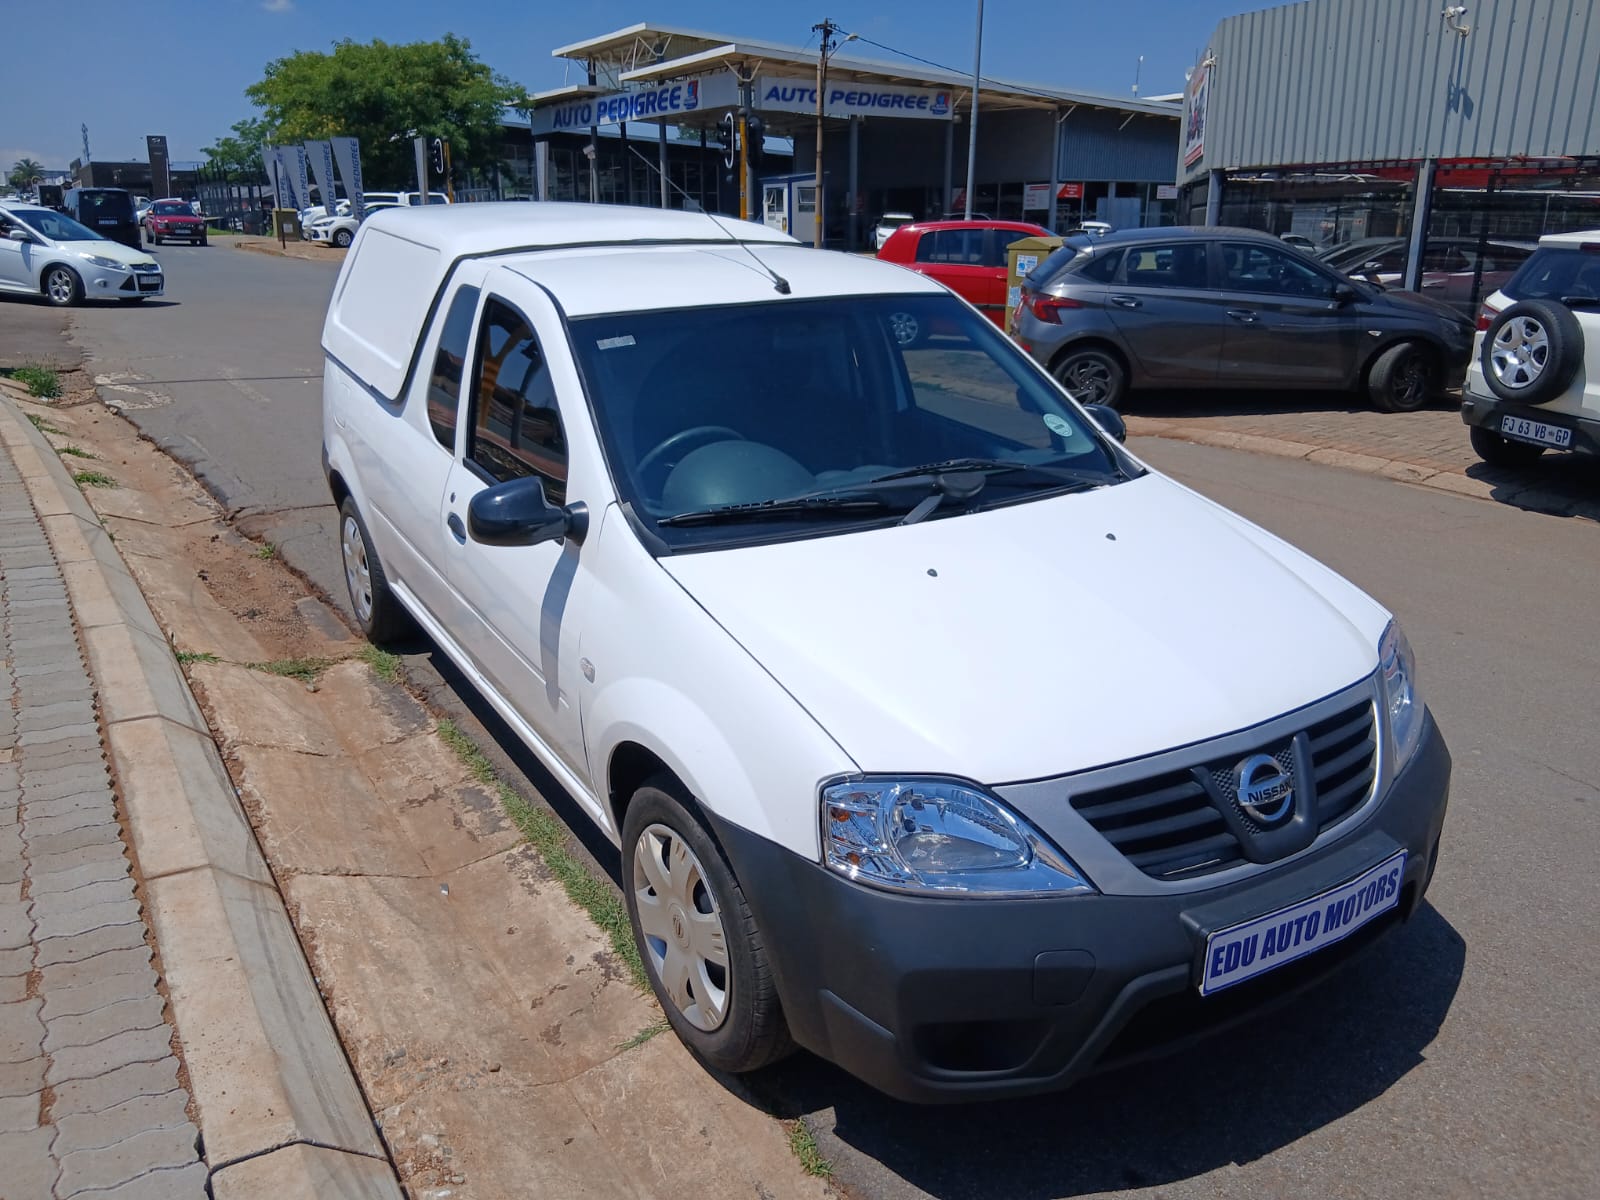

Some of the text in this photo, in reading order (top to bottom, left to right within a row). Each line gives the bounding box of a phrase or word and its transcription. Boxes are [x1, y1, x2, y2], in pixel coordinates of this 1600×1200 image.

[553, 86, 682, 128] AUTO PEDIGREE
[829, 90, 929, 110] PEDIGREE
[323, 143, 334, 188] PEDIGREE
[350, 140, 361, 189] PEDIGREE
[1502, 417, 1569, 444] FJ 63 VB GP
[1247, 781, 1292, 803] NISSAN
[1209, 867, 1399, 979] EDU AUTO MOTORS
